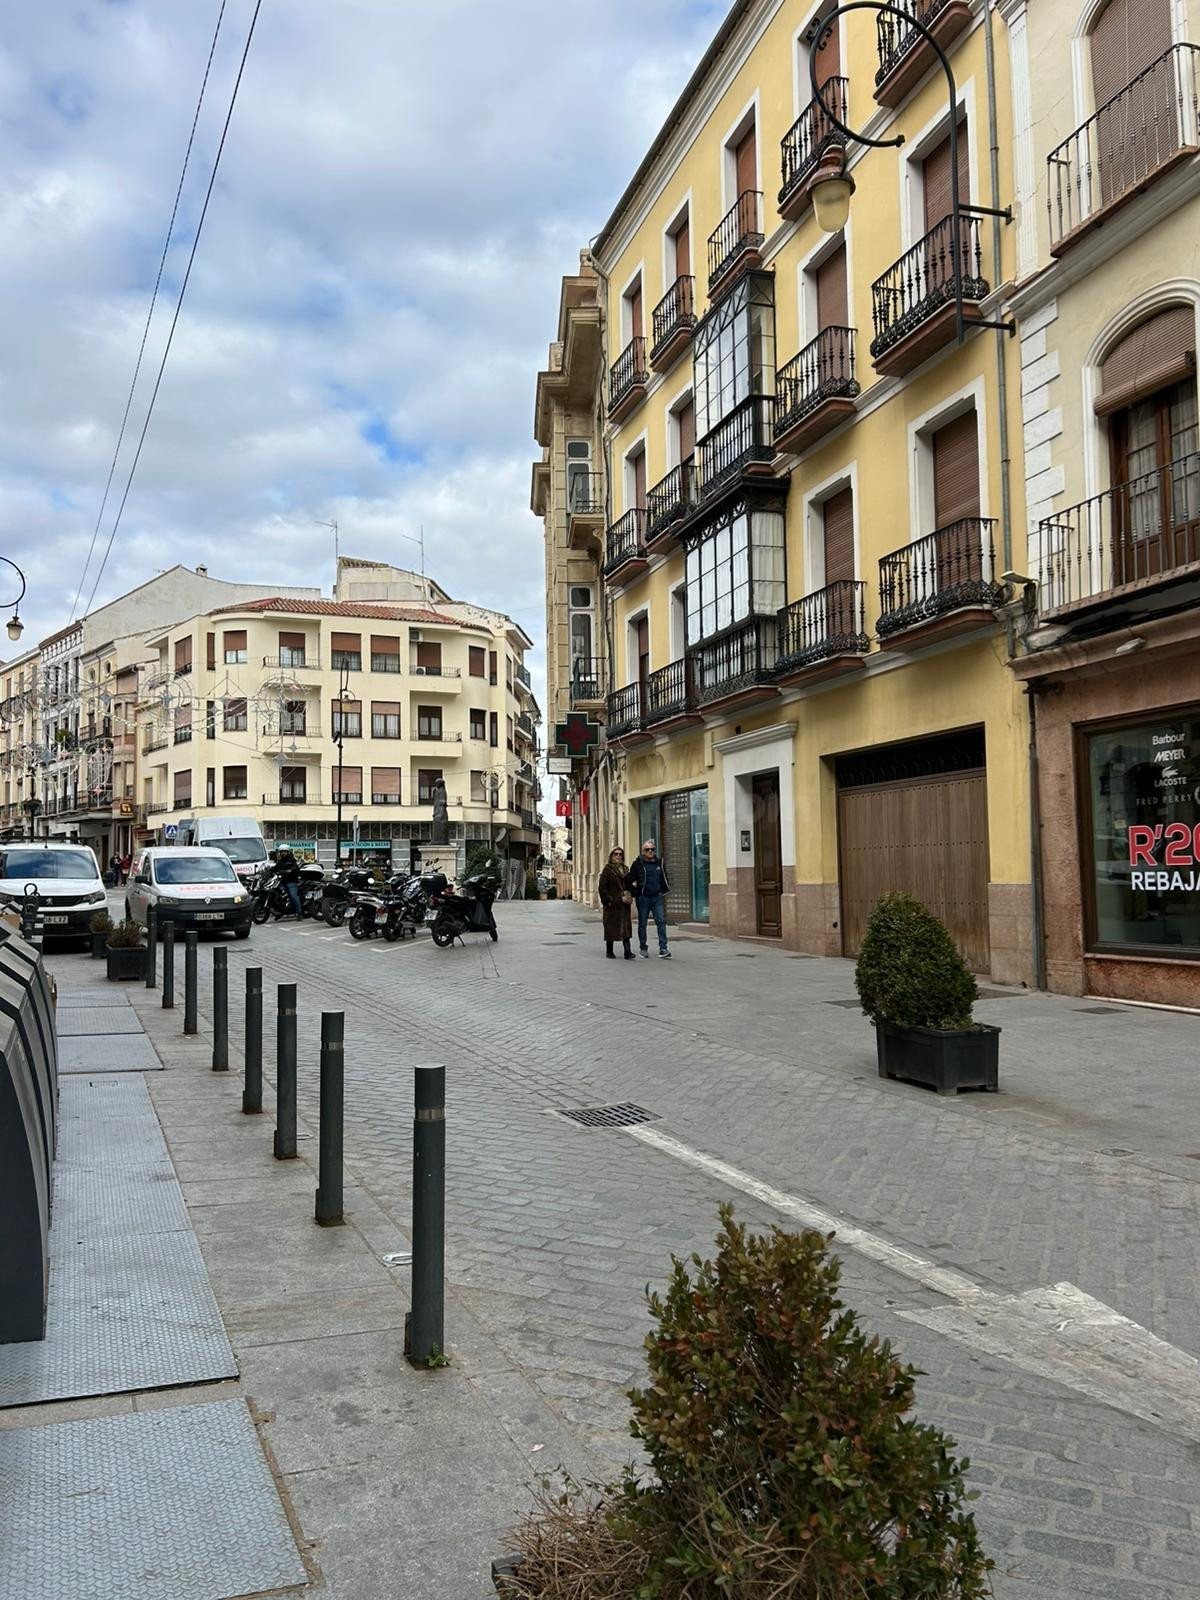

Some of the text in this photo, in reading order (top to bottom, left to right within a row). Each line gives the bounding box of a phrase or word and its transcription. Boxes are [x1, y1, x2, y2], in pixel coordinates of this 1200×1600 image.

[1152, 733, 1185, 745] Barbour
[1154, 748, 1186, 763] MEYER
[1154, 777, 1187, 787] LACOSTE
[1136, 797, 1158, 807] FRED
[1163, 794, 1193, 804] PERRY
[1128, 822, 1200, 867] R'2
